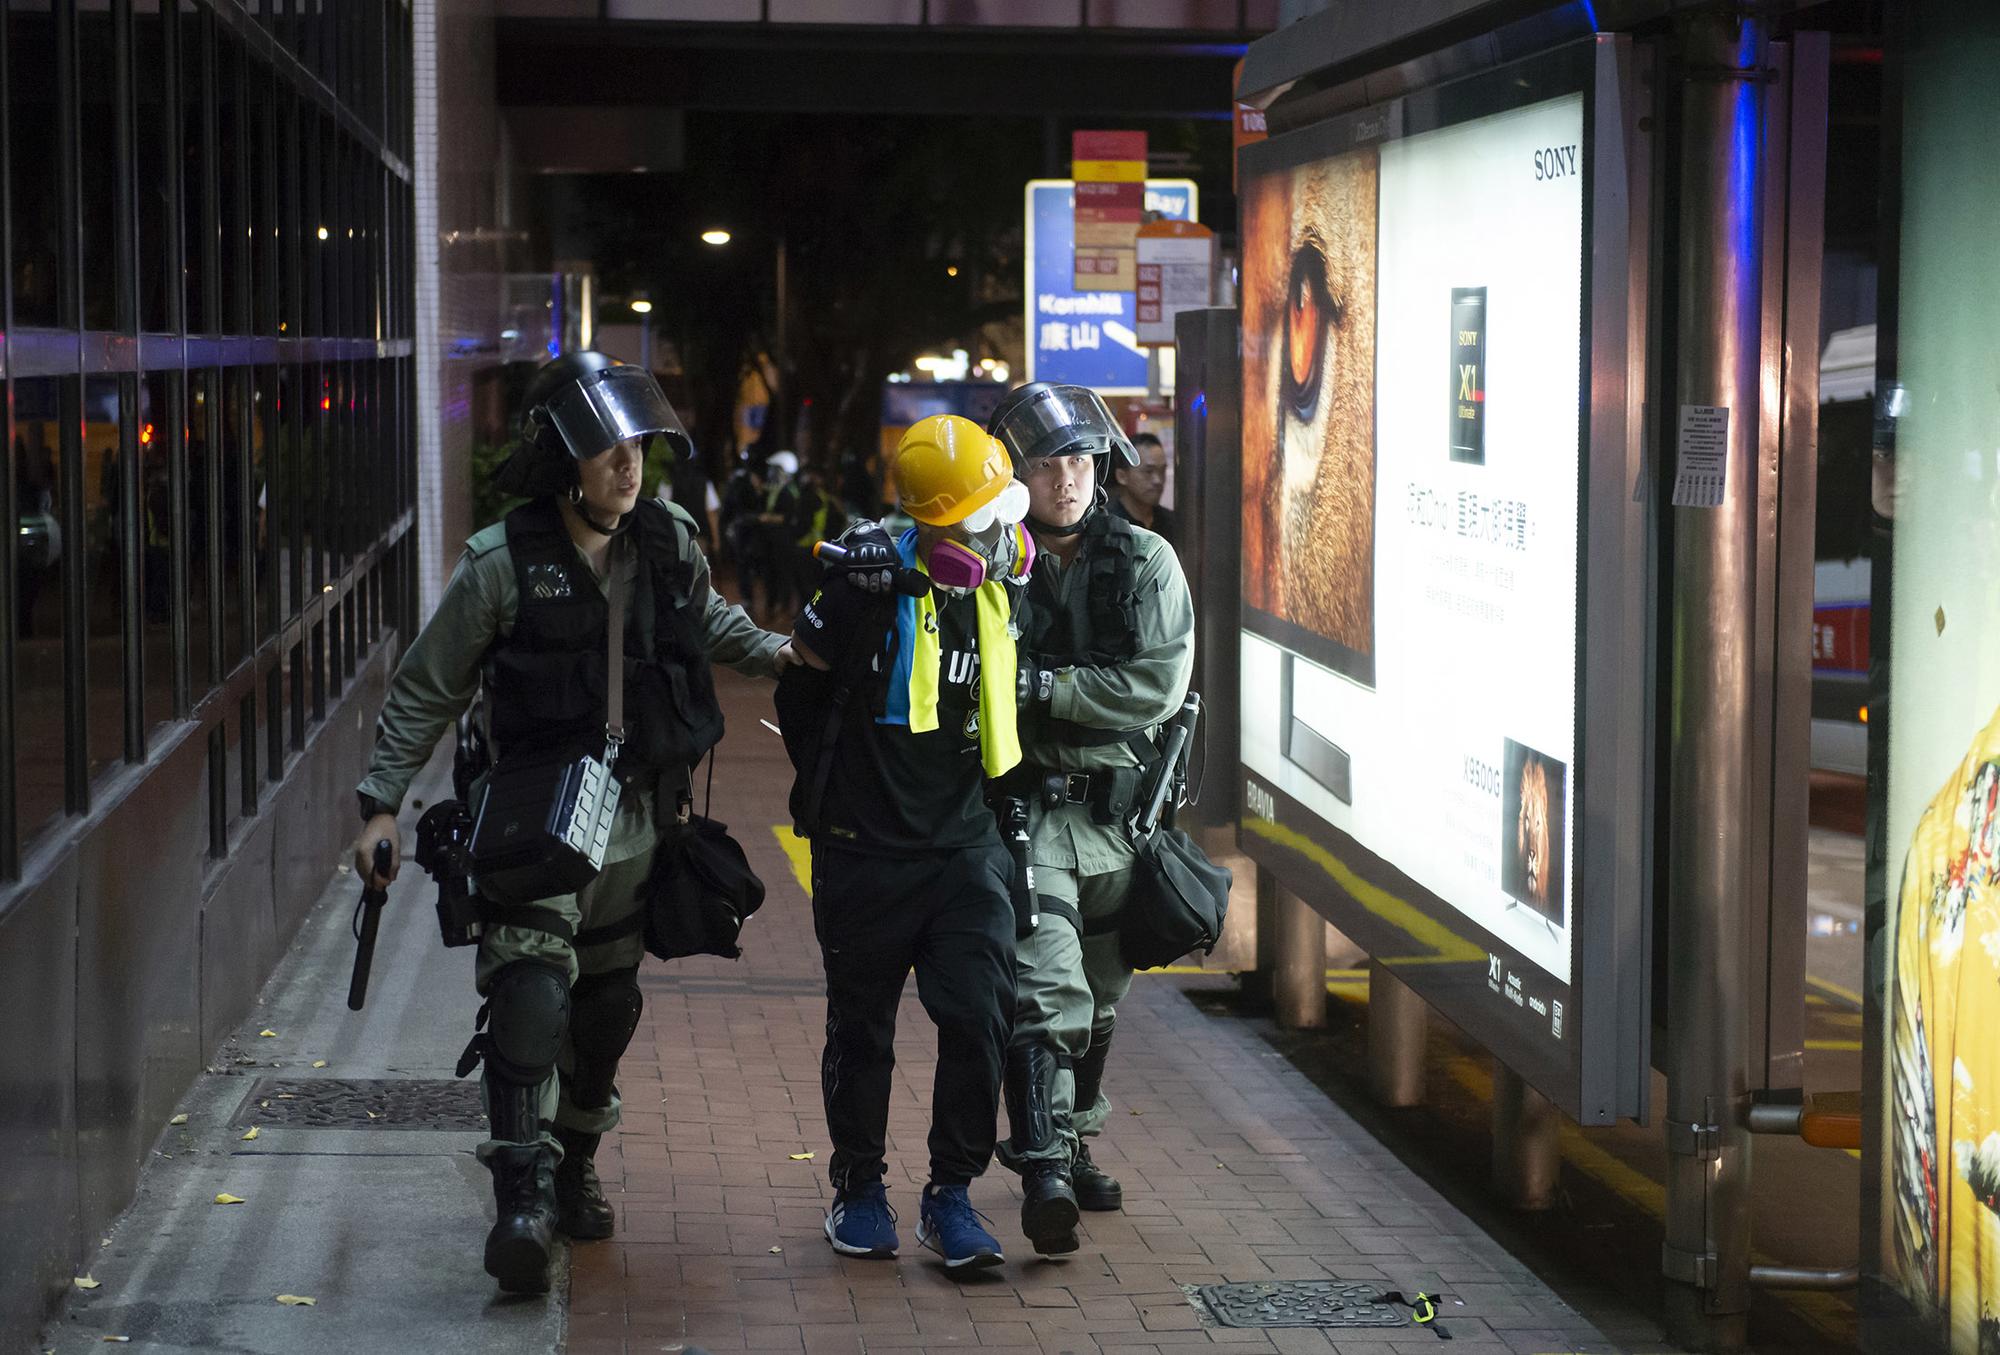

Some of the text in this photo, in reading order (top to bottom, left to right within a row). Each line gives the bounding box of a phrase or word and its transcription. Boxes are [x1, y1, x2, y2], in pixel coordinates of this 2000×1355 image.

[1535, 145, 1576, 181] SONY
[1458, 330, 1478, 346] SONY
[1458, 364, 1477, 401] X1
[1464, 753, 1501, 798] X9500G
[1247, 779, 1275, 826] BRAVIA
[1488, 952, 1501, 983] X1
